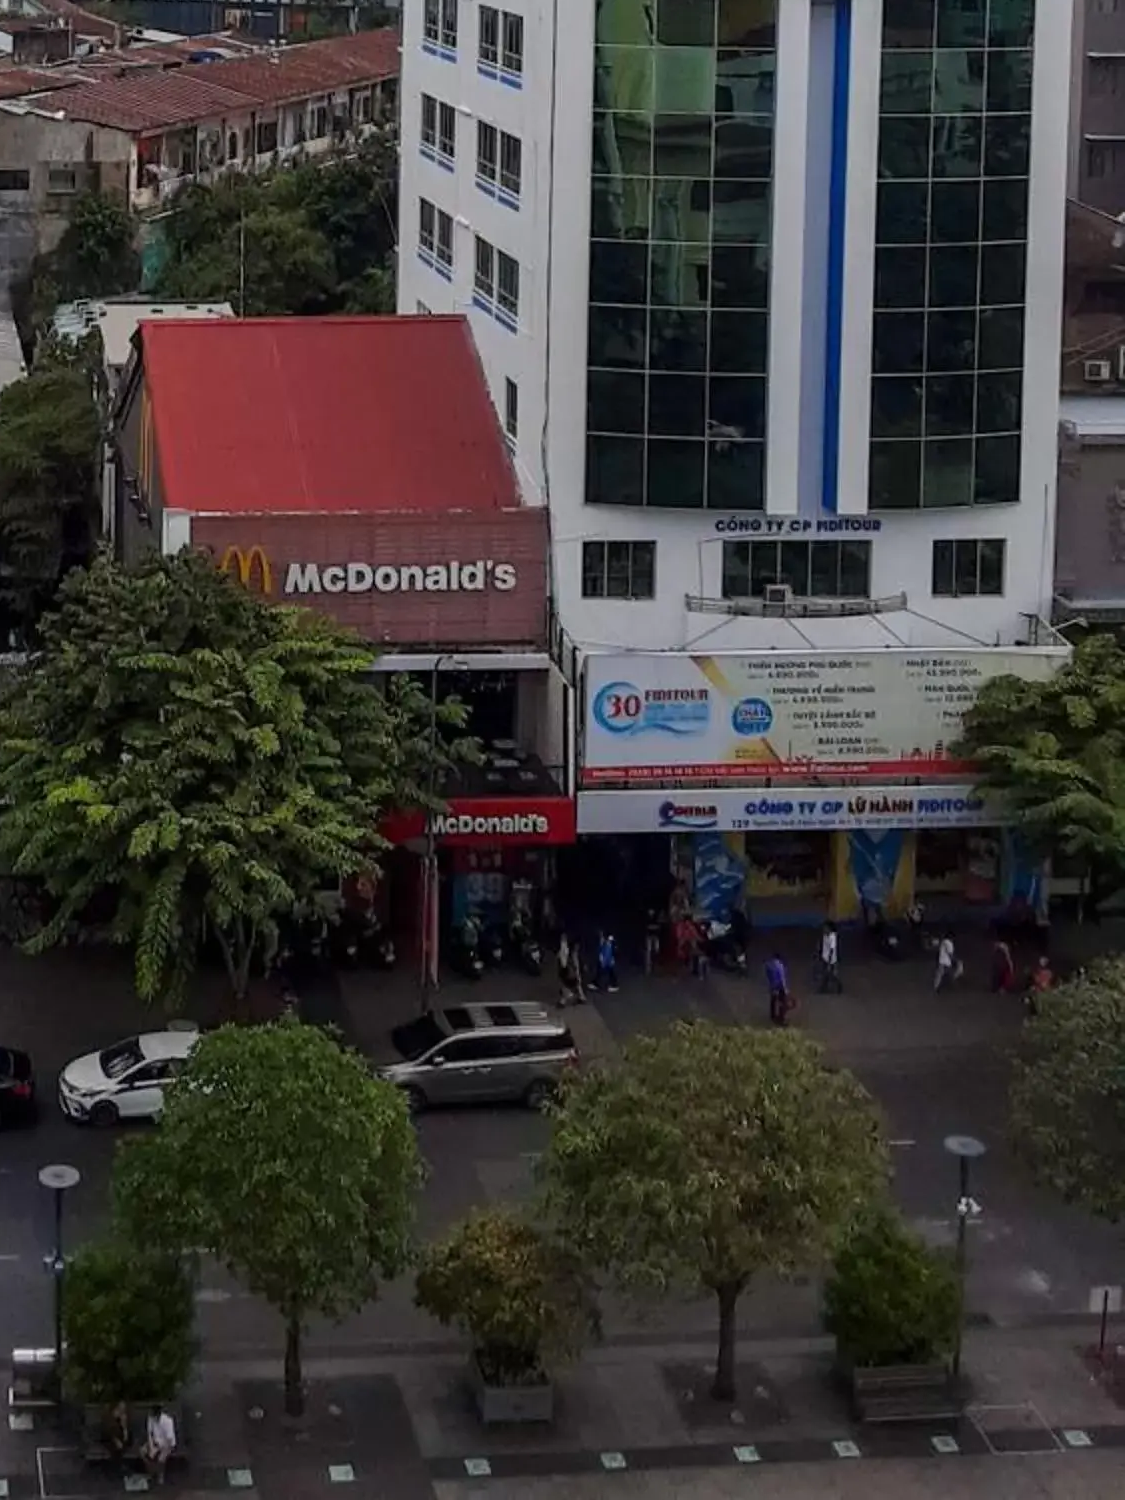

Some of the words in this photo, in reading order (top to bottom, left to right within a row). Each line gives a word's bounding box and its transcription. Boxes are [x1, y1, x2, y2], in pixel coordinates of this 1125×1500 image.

[766, 518, 785, 532] TY
[789, 518, 813, 533] CP
[284, 560, 517, 594] McDonald's
[606, 693, 642, 718] 30
[798, 801, 817, 815] TY
[821, 801, 843, 815] CP
[871, 797, 914, 814] HÀNH
[425, 814, 549, 835] McDonald's
